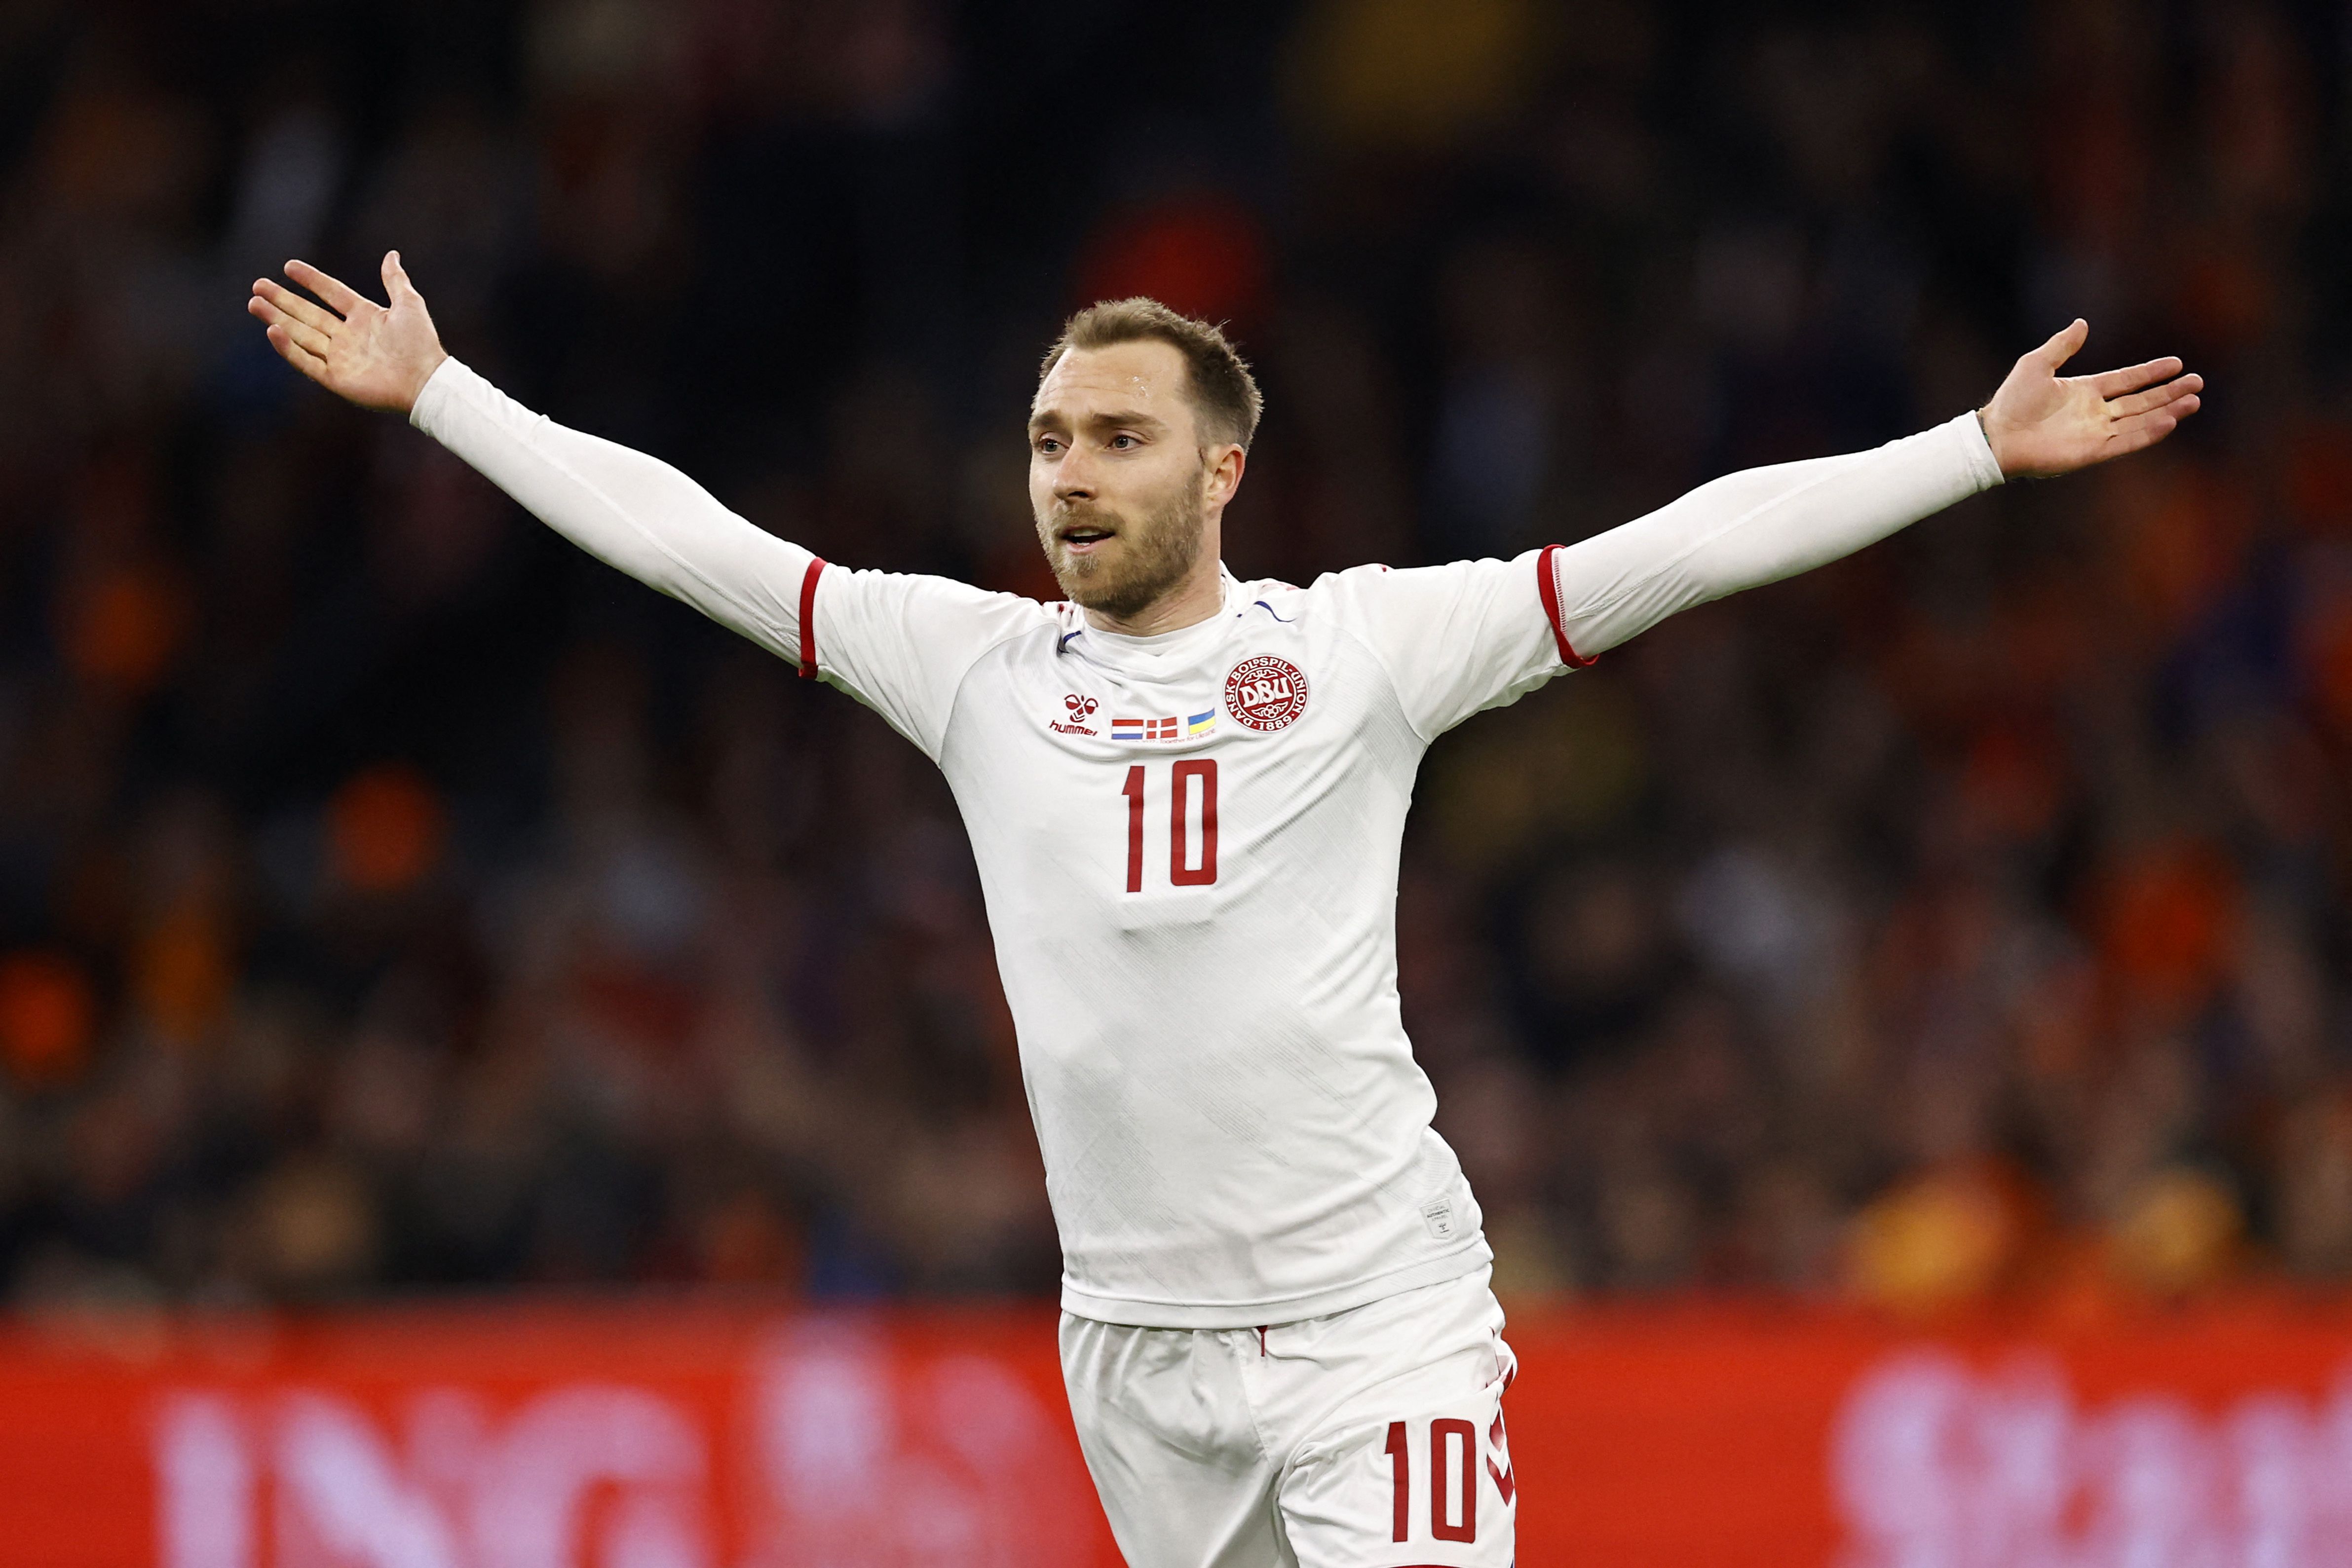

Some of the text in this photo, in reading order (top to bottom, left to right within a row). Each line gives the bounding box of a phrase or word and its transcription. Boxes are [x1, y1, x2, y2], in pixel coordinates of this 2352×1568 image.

[1226, 684, 1254, 727] DANSK
[1259, 715, 1292, 731] 1889
[1239, 677, 1292, 708] DBU
[1049, 719, 1098, 737] hummel
[1121, 758, 1217, 893] 10
[1384, 1418, 1476, 1544] 10
